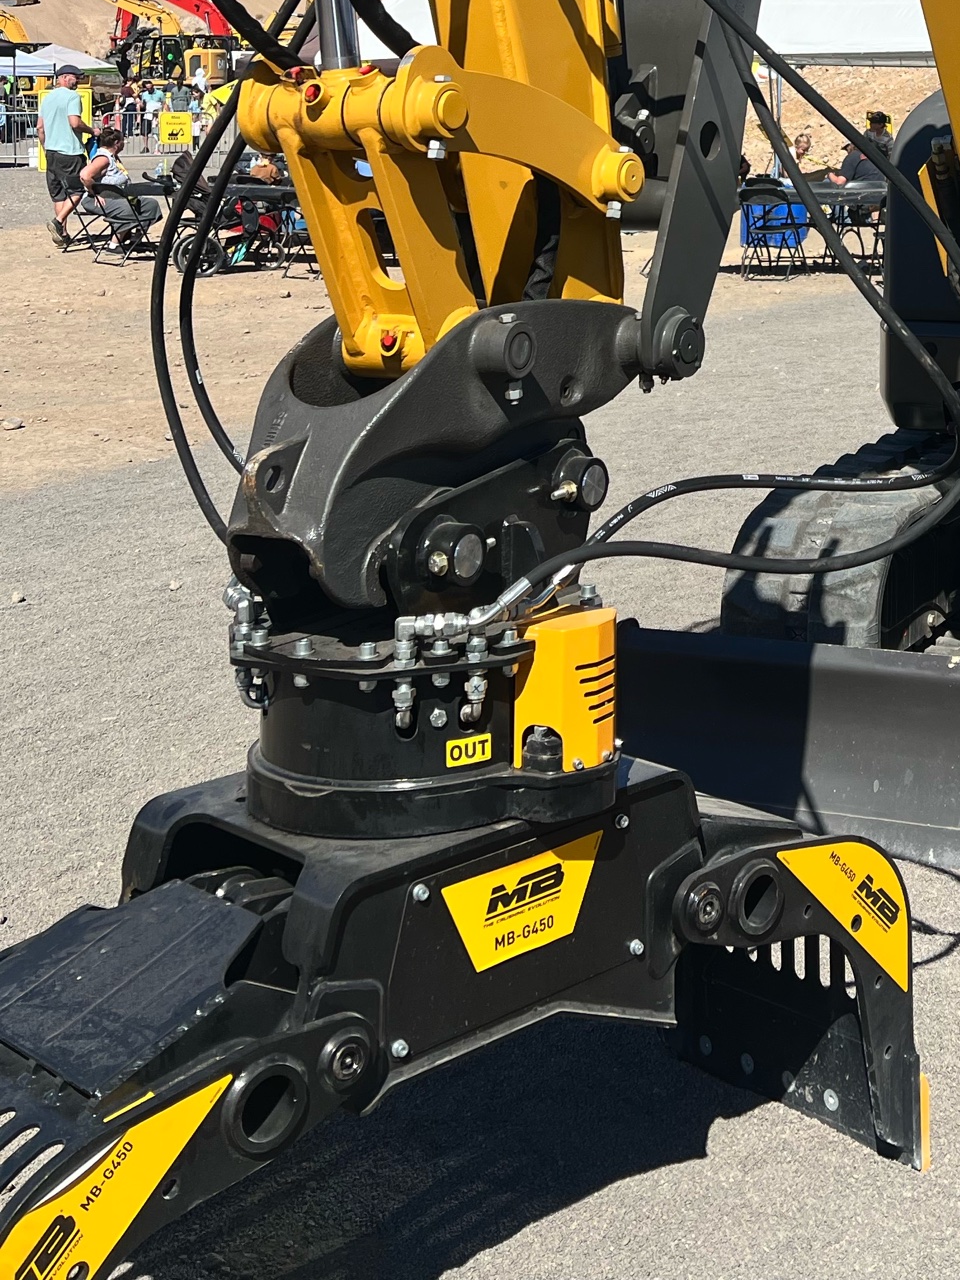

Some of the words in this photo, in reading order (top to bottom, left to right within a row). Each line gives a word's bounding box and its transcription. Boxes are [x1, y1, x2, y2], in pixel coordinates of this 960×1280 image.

[449, 738, 489, 762] OUT
[486, 862, 565, 916] MB
[829, 851, 857, 883] MB-G450
[856, 873, 901, 926] MB
[494, 914, 554, 951] MB-G450
[79, 1141, 134, 1212] MB-G450
[49, 1233, 84, 1280] VOLUTION
